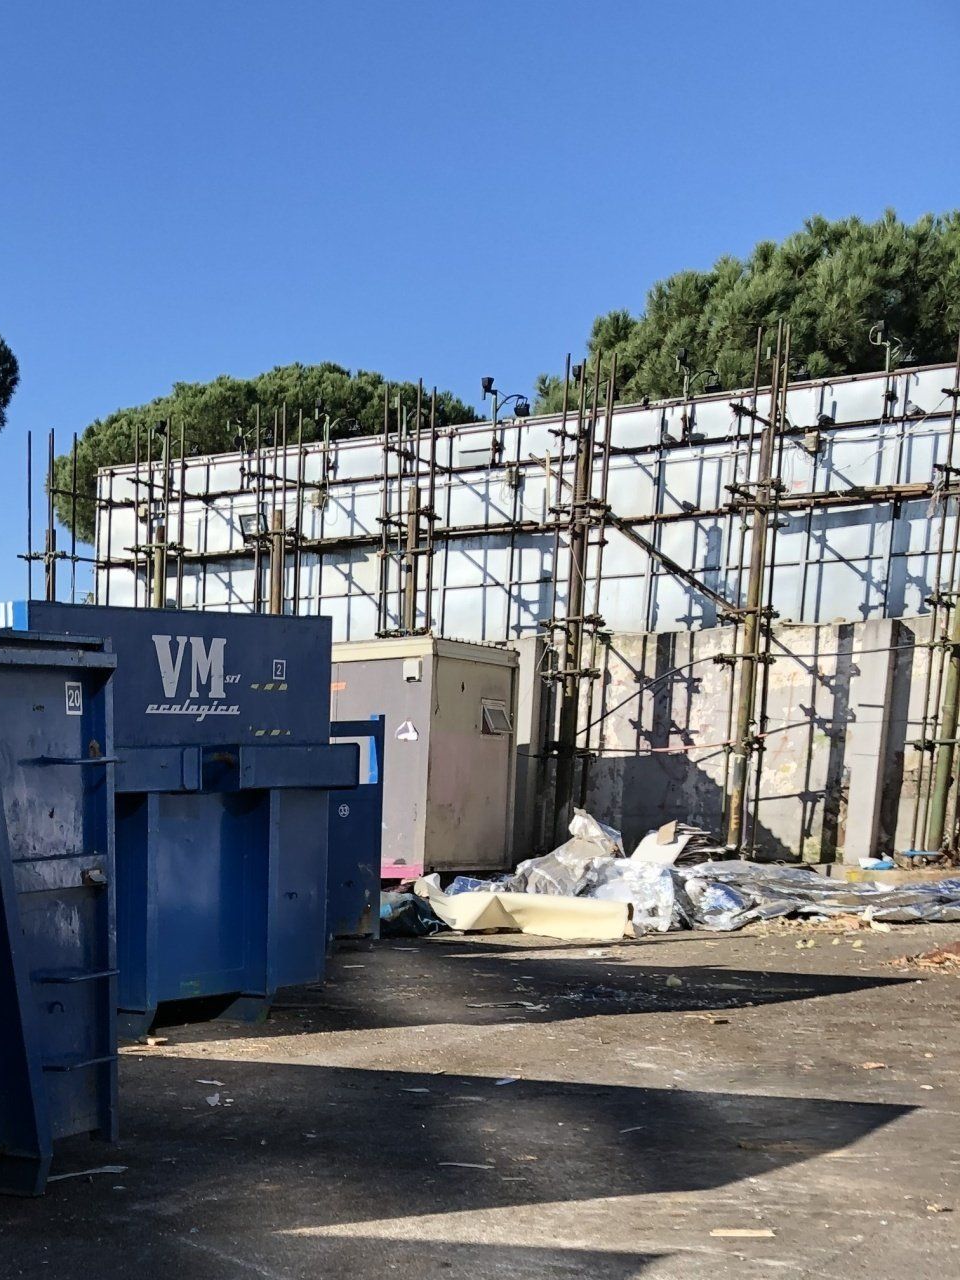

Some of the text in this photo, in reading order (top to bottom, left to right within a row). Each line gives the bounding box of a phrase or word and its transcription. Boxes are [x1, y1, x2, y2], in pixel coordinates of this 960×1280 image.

[152, 635, 227, 698] VM
[276, 664, 283, 675] 2
[68, 689, 81, 707] 20
[145, 700, 240, 722] ecologica
